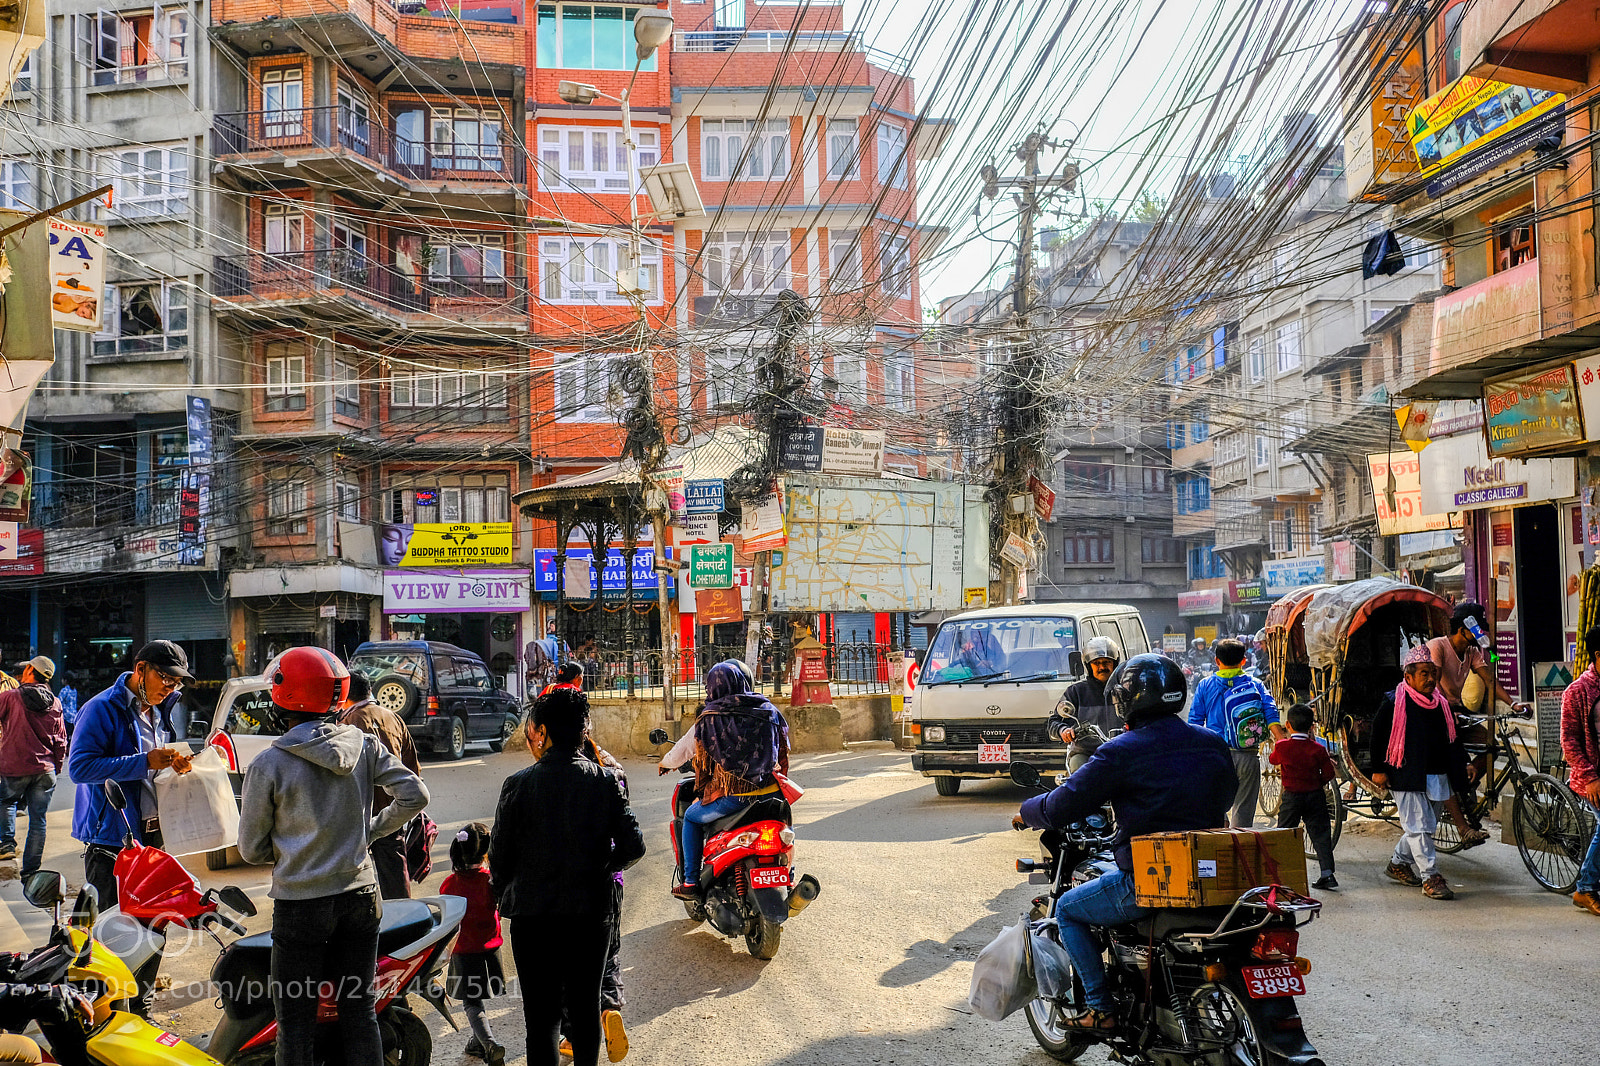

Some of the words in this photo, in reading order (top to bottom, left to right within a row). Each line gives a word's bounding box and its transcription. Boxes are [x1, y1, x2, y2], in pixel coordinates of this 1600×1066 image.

[1423, 102, 1438, 117] The
[1376, 147, 1417, 164] PALAC
[1491, 424, 1519, 442] Kiran
[1521, 416, 1547, 435] Fruit
[1550, 415, 1559, 429] &
[826, 430, 850, 440] Hotel
[825, 439, 850, 449] Ganesh
[862, 441, 882, 450] Himal
[1463, 460, 1505, 487] Ncell
[687, 488, 705, 498] LAI
[706, 487, 722, 497] LAI
[1457, 490, 1487, 506] CLASSIC
[1487, 486, 1519, 501] GALLERY
[411, 547, 445, 557] BUDDHA
[447, 547, 478, 557] TATTOO
[480, 546, 509, 556] STUDIO
[590, 570, 657, 581] PHARMAC
[695, 575, 727, 585] CHHETRAPATI
[391, 583, 450, 600] VIEW
[458, 580, 523, 599] POINT
[1236, 589, 1246, 598] ON
[1246, 587, 1261, 598] HIRE
[593, 592, 645, 600] PHARMCY
[956, 620, 1058, 631] TOYOTA
[1251, 977, 1303, 995] ३४५२
